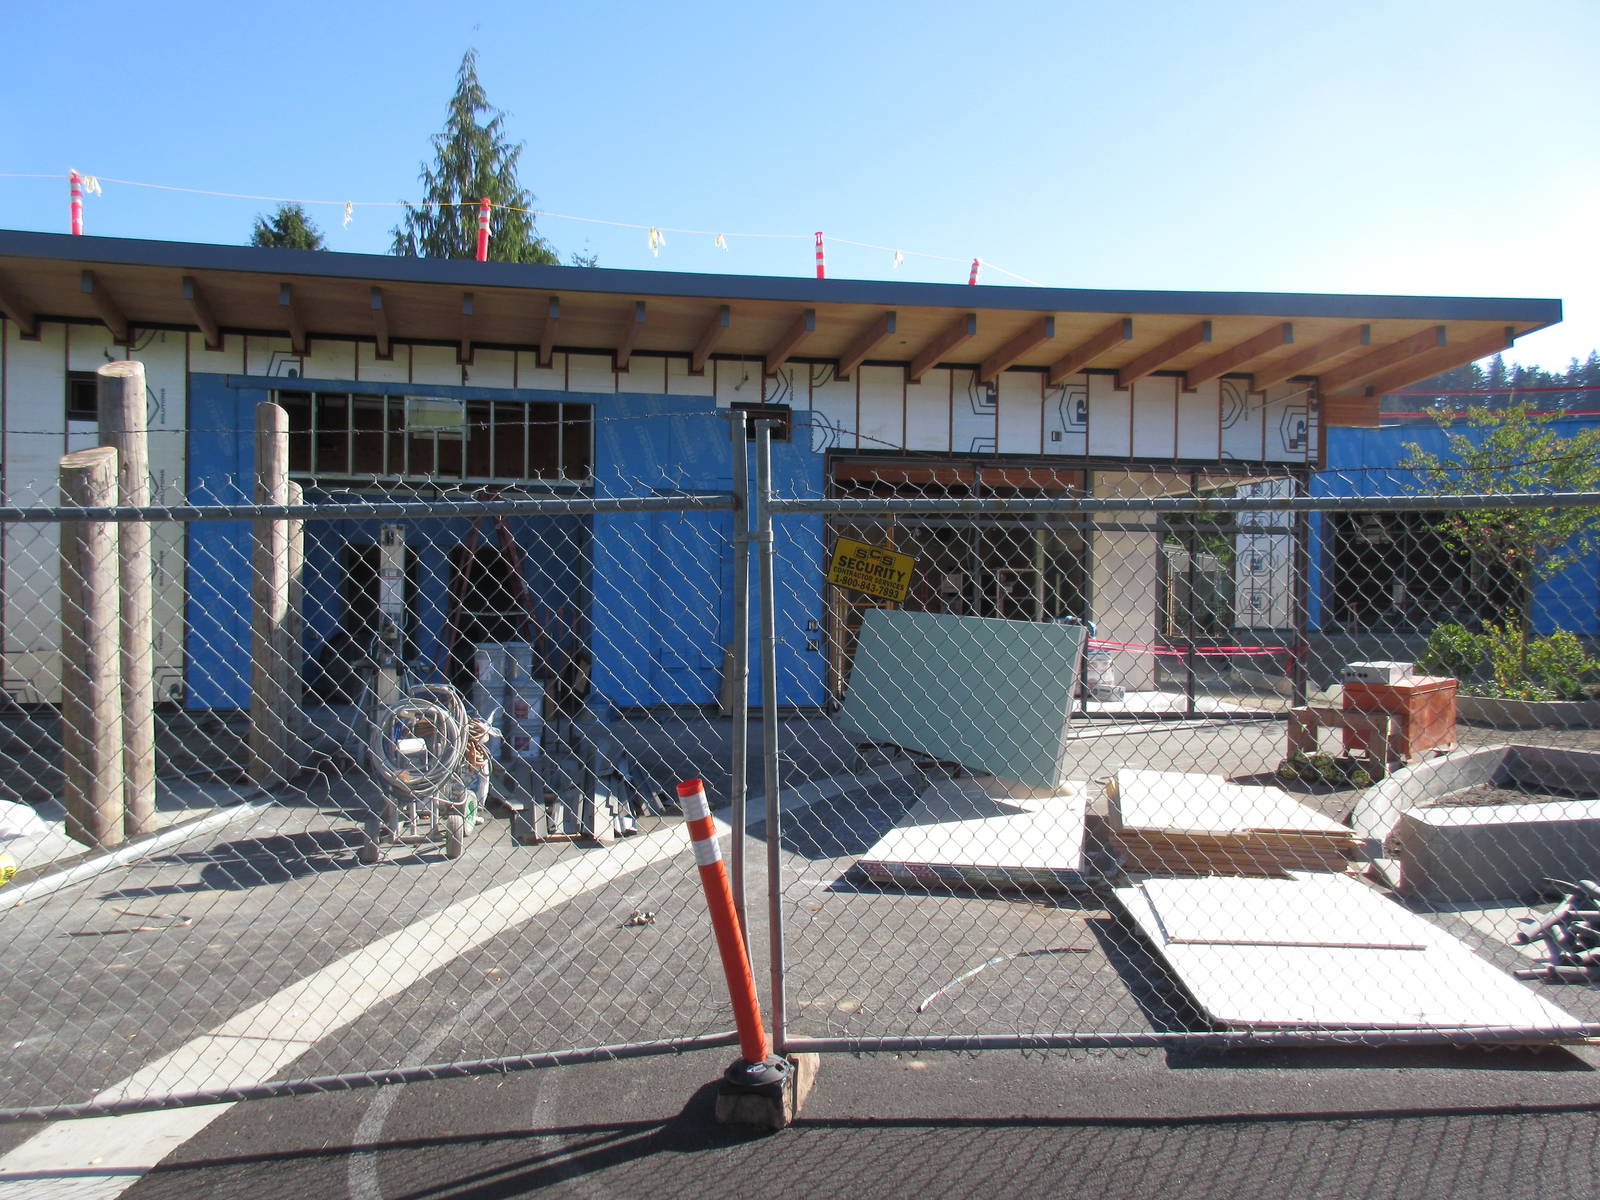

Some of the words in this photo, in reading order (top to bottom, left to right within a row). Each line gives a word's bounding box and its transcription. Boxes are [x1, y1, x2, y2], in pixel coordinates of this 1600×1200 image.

[838, 555, 906, 582] SECURITY
[855, 547, 896, 567] SCS
[833, 566, 873, 582] CONTRACTOR
[875, 576, 904, 591] SERVICES
